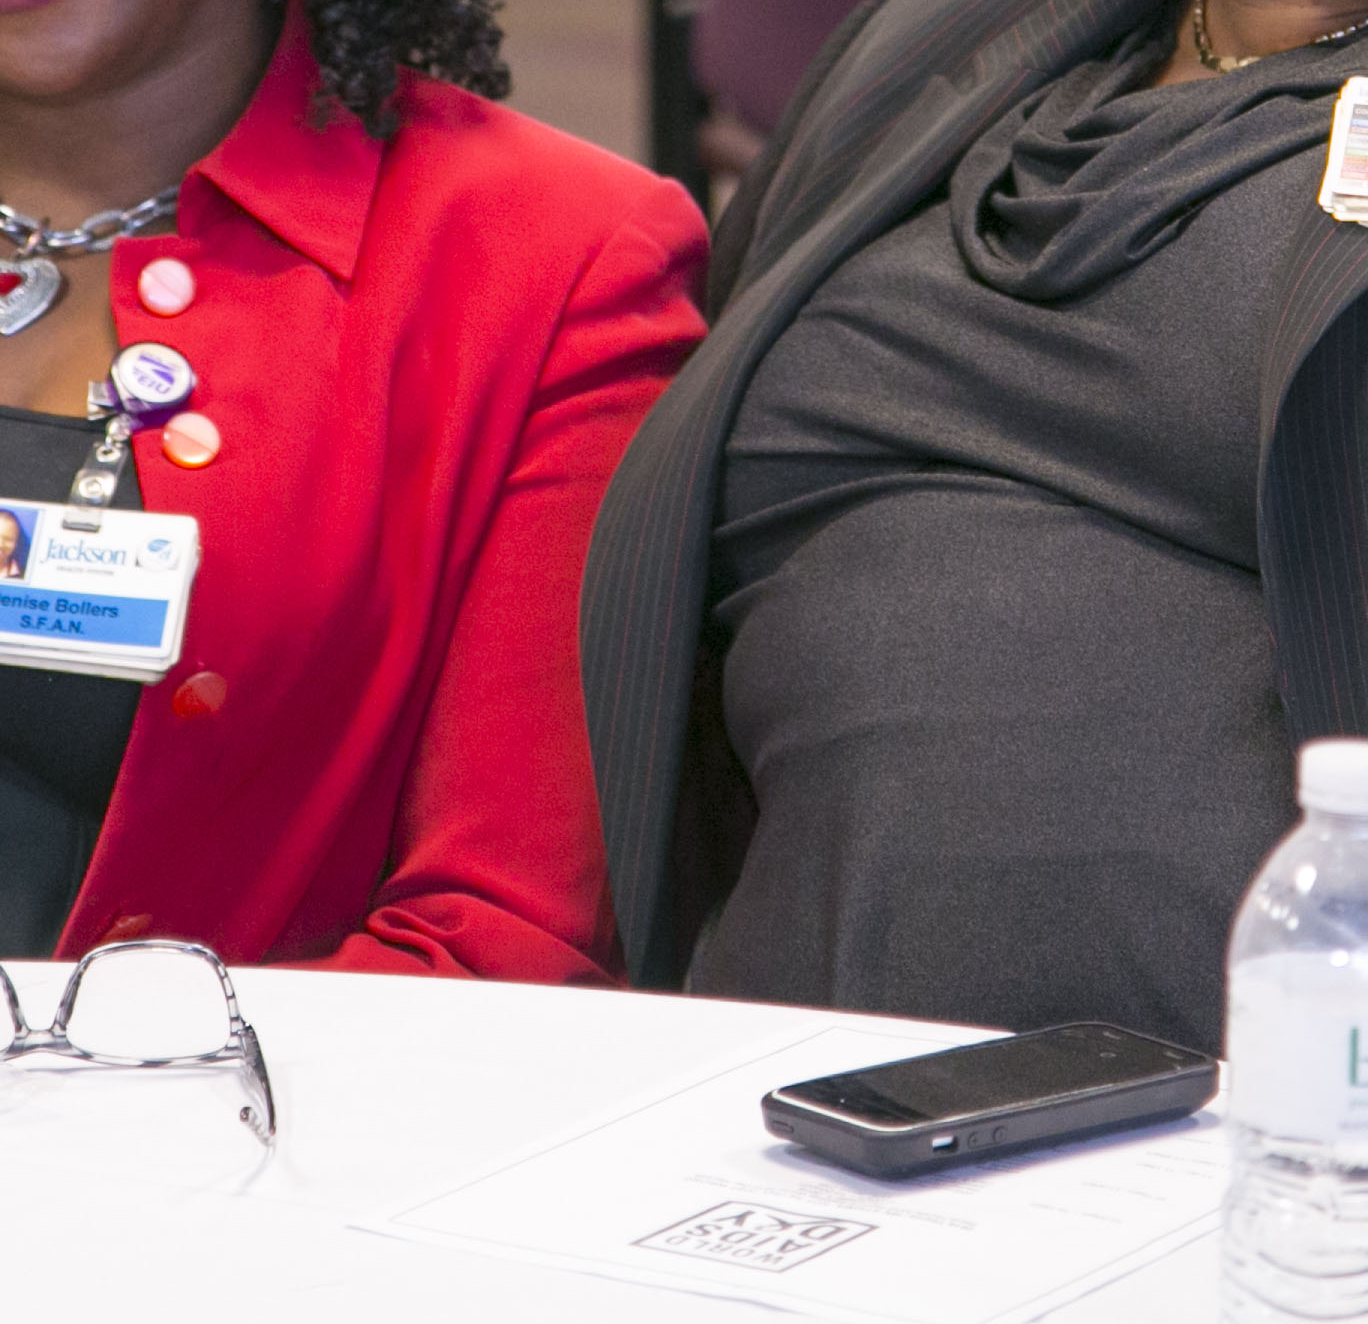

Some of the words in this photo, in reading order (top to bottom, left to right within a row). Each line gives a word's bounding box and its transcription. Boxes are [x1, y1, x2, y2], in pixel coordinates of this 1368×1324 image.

[40, 537, 126, 565] Jackson
[55, 598, 119, 618] Bollers
[20, 614, 85, 635] S.F.A.N.
[665, 1235, 784, 1264] WORLD
[686, 1223, 814, 1254] AIDS
